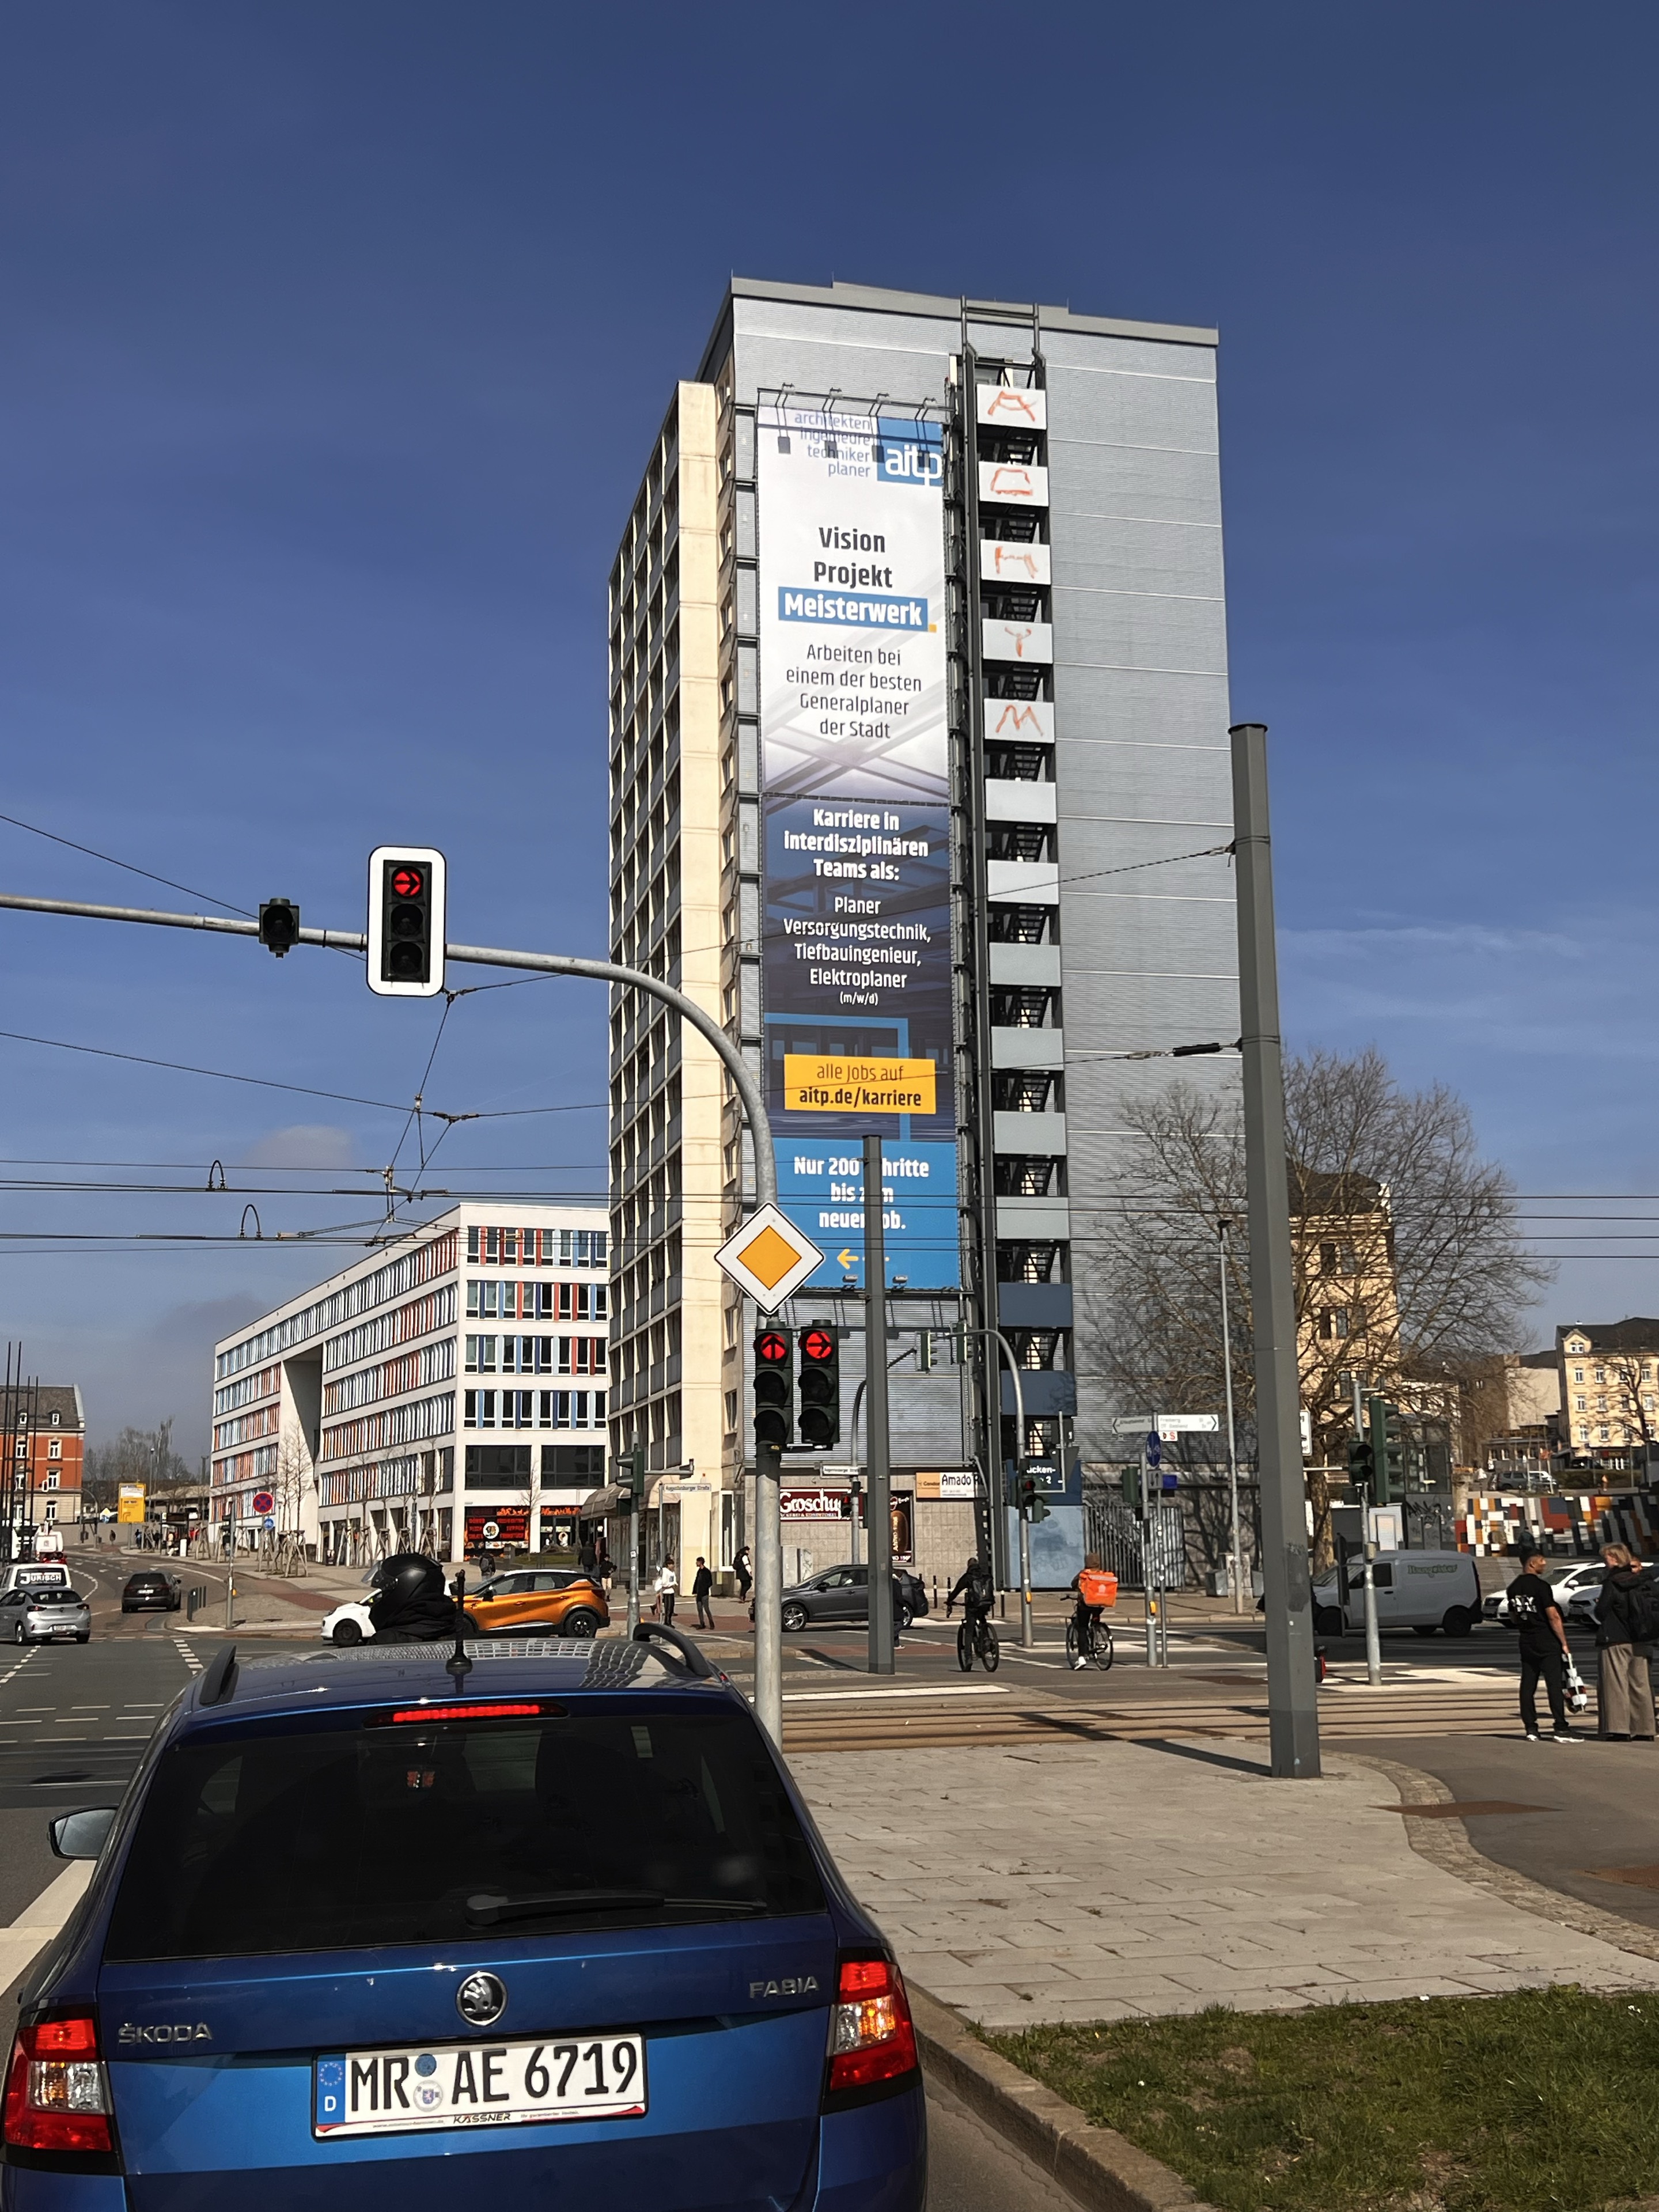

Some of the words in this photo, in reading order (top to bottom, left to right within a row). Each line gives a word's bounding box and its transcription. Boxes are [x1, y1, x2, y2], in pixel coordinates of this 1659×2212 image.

[794, 412, 870, 430] architekten
[807, 445, 870, 462] techniker
[828, 463, 870, 477] planer
[819, 527, 885, 553] Vision
[814, 561, 893, 589] Projekt
[806, 644, 872, 663] Arbeiten
[878, 648, 901, 665] bei
[786, 666, 834, 685] einem
[840, 671, 865, 688] der
[870, 672, 922, 692] besten
[800, 693, 910, 715] Generalplaner
[820, 718, 846, 736] der
[850, 721, 891, 738] Stadt
[813, 809, 880, 830] Karriere
[884, 812, 900, 831] in
[784, 830, 929, 857] interdisziplinären
[813, 858, 867, 878] Teams
[870, 861, 900, 881] als:
[835, 896, 881, 915] Planer
[783, 918, 931, 943] Versorgungstechnik,
[794, 943, 921, 967] Tiefbauingenieur,
[810, 968, 907, 989] Elektroplaner
[839, 991, 878, 1006] (m/w/d)
[817, 1063, 842, 1080] alle
[847, 1065, 876, 1083] Jobs
[881, 1066, 904, 1081] auf
[799, 1086, 922, 1108] aitp.de/karriere
[794, 1156, 824, 1175] Nur
[828, 1158, 860, 1176] 200
[882, 1158, 929, 1177] hritte
[831, 1183, 856, 1202] bis
[859, 1187, 893, 1203] zm
[882, 1210, 906, 1229] ob.
[942, 1474, 971, 1486] Amado
[780, 1488, 842, 1520] Groschu
[749, 1976, 820, 1999] FABIA
[118, 2021, 213, 2044] ŠKODA
[351, 2054, 410, 2112] MR
[452, 2048, 510, 2104] AE
[524, 2041, 637, 2099] 6719
[324, 2096, 336, 2112] D
[453, 2113, 511, 2124] KASSNER
